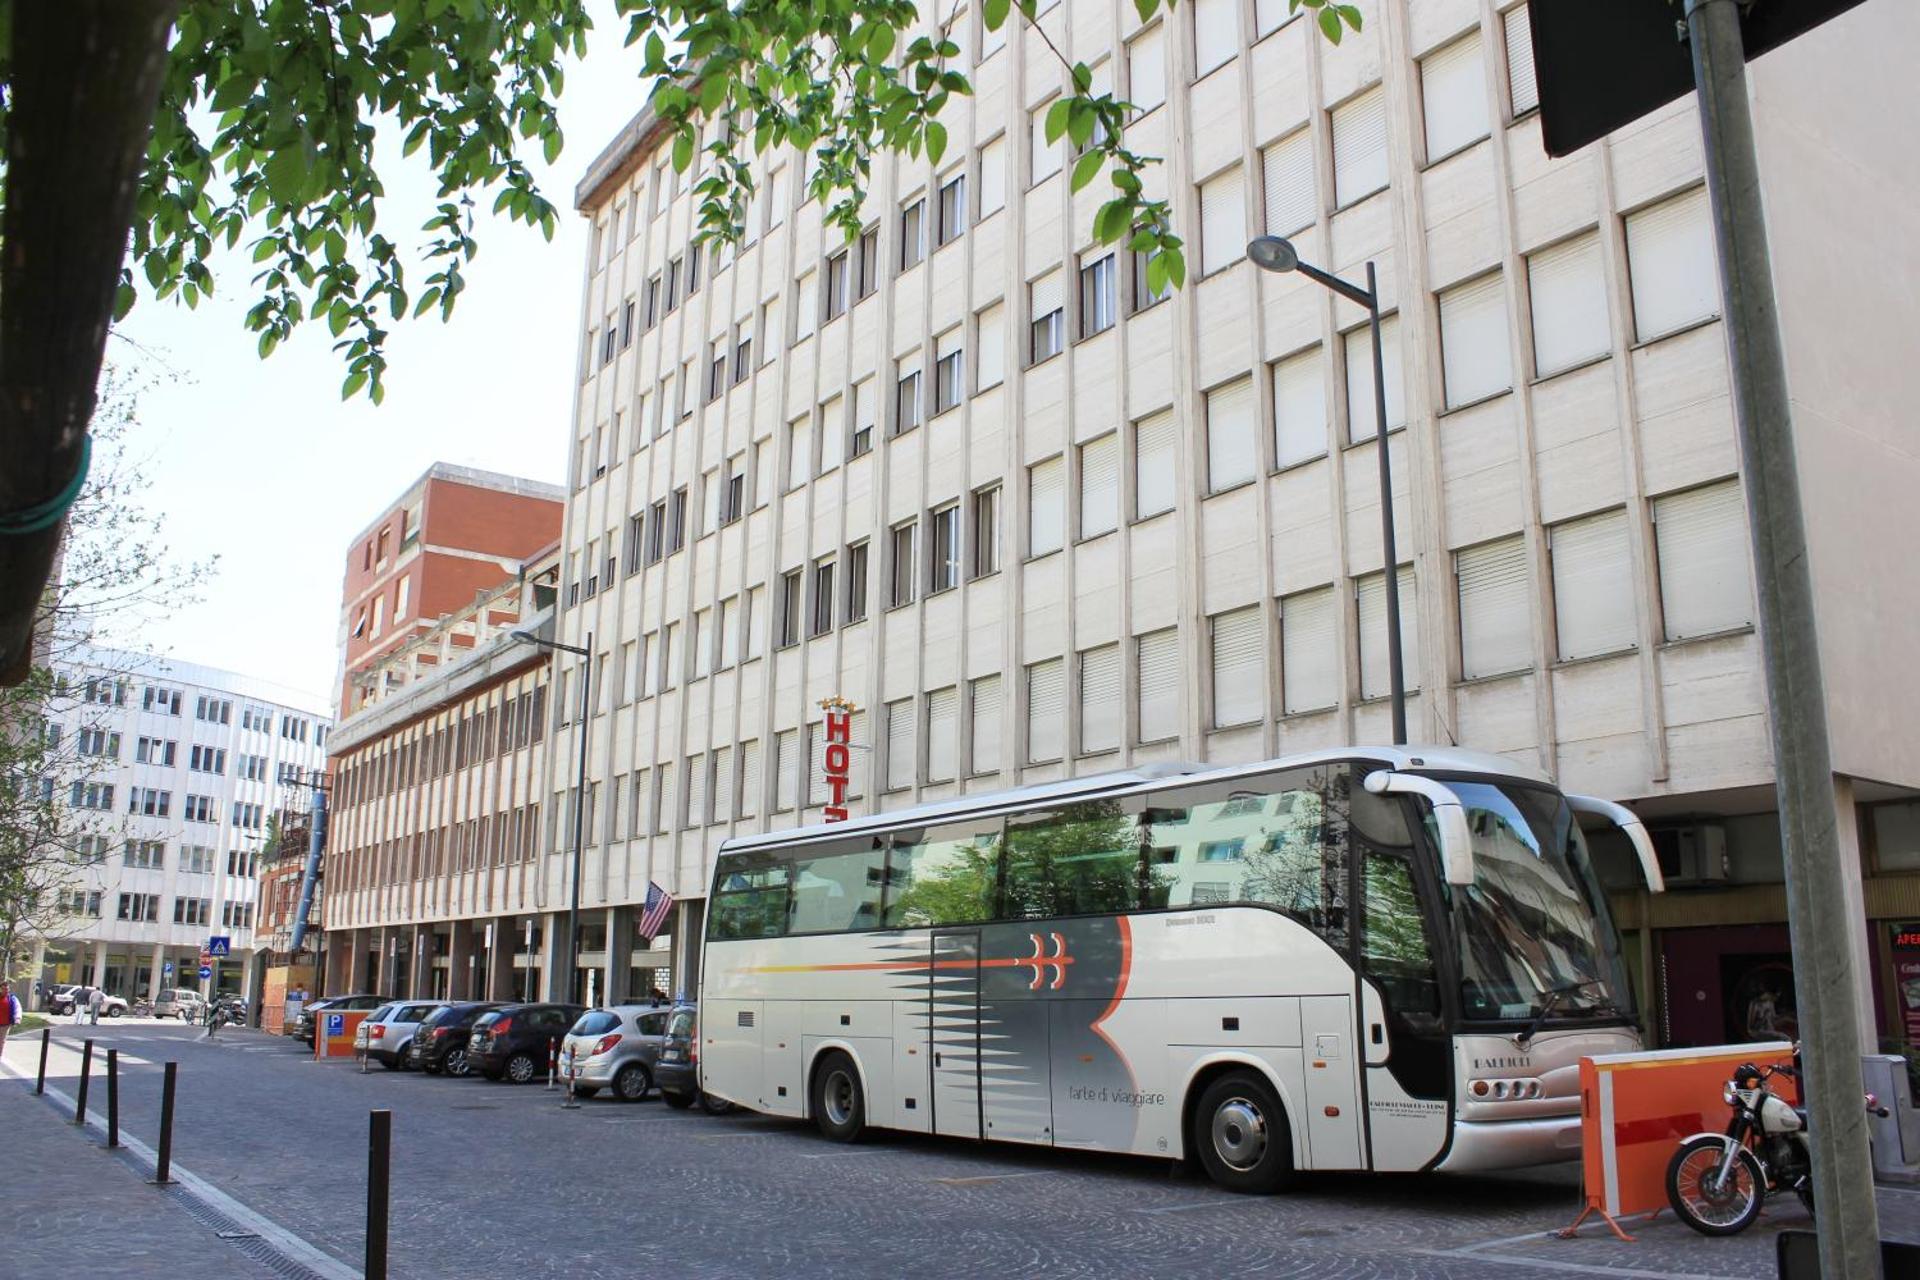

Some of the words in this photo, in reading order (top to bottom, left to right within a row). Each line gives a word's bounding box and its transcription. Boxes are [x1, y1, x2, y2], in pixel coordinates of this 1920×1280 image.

[331, 1015, 341, 1027] P
[1098, 1087, 1108, 1102] di
[1111, 1089, 1165, 1108] viaggiare
